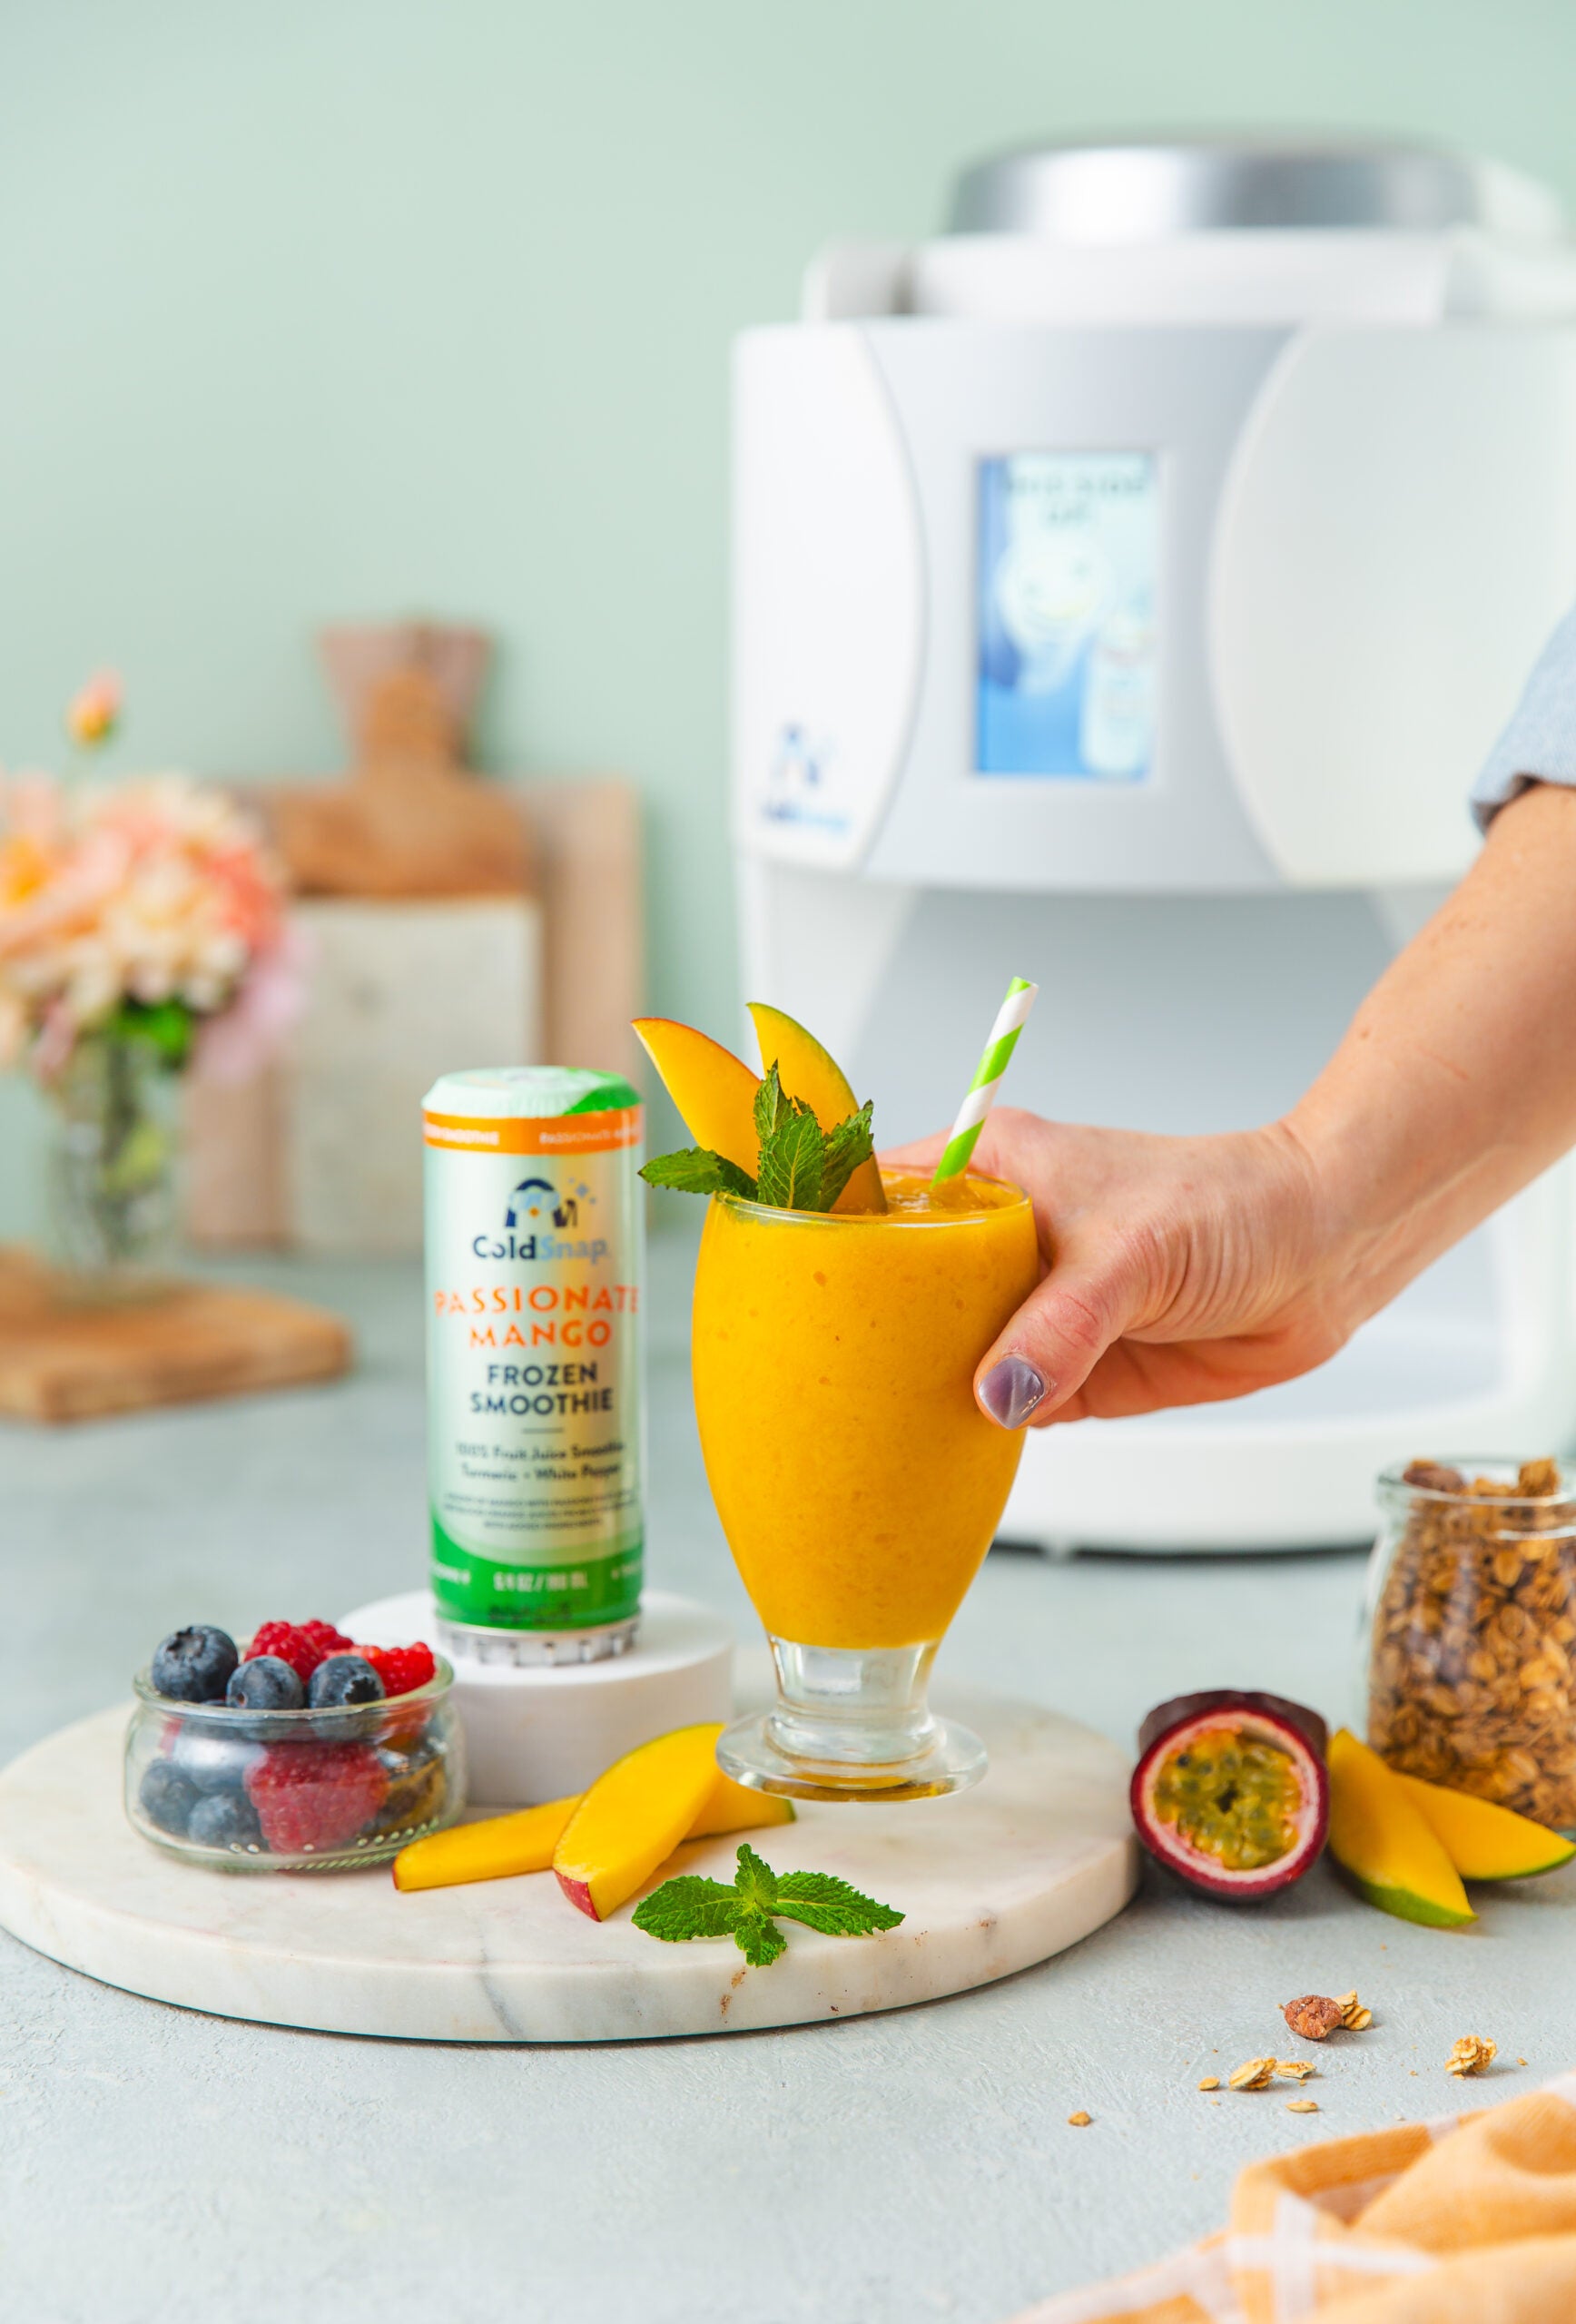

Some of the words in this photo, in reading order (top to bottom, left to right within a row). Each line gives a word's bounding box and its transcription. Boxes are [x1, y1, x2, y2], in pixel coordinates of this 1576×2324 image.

[473, 1236, 608, 1265] ColdSnap
[434, 1285, 639, 1316] PASSIONATE
[468, 1319, 613, 1349] MANGO
[487, 1361, 597, 1387] FROZEN
[469, 1388, 614, 1415] SMOOTHIE
[493, 1444, 527, 1459] Fruit
[532, 1445, 567, 1461] Juice
[535, 1467, 576, 1480] White
